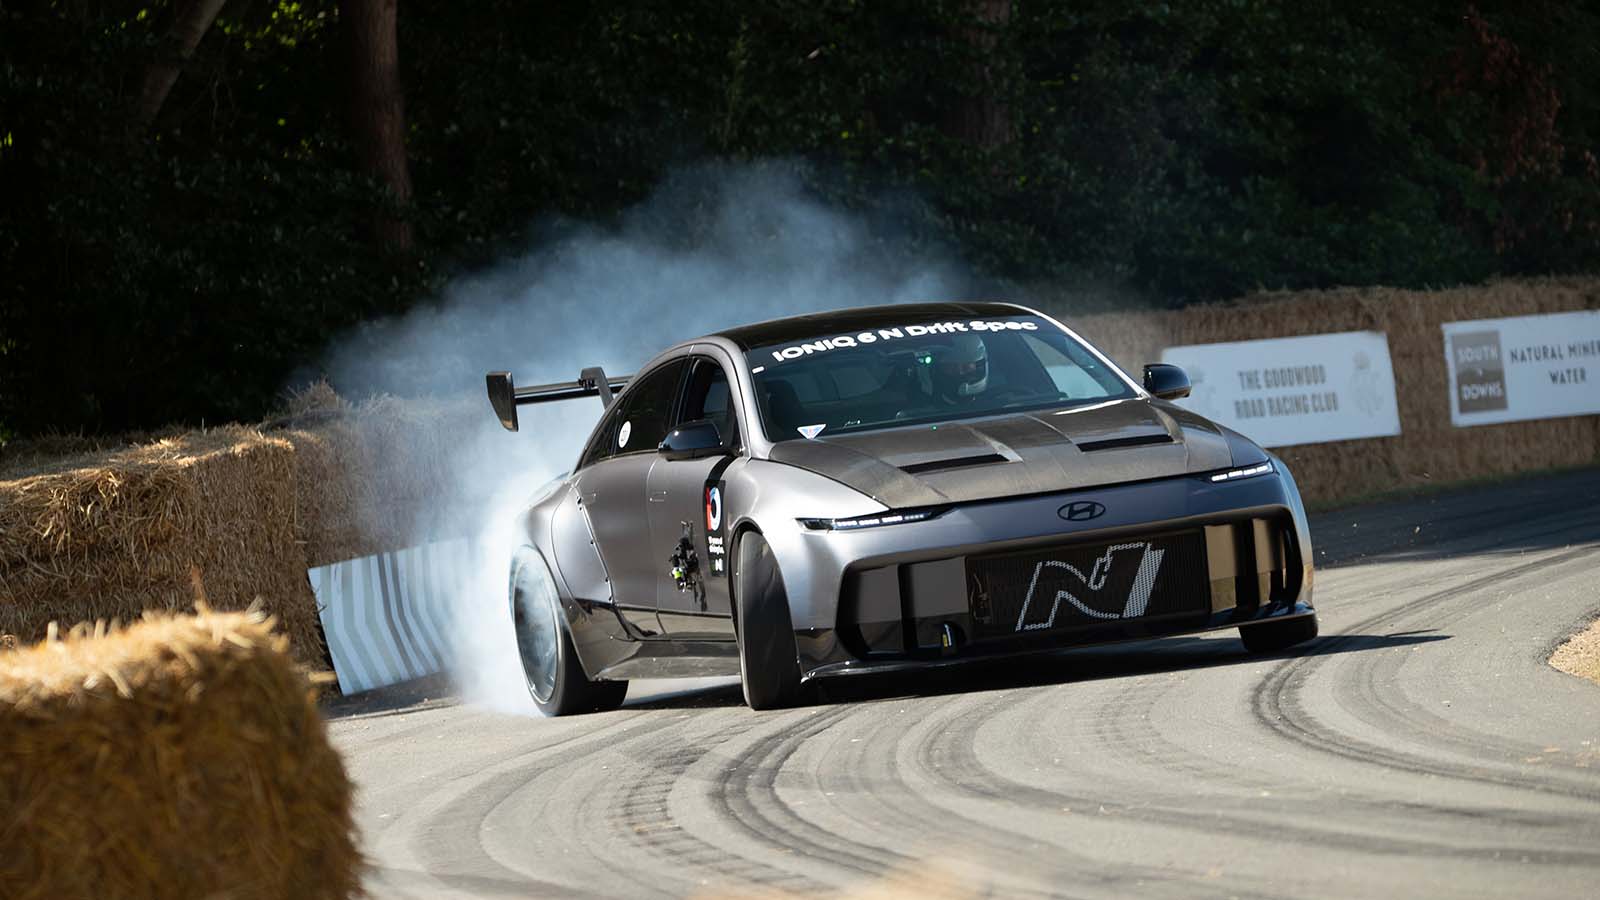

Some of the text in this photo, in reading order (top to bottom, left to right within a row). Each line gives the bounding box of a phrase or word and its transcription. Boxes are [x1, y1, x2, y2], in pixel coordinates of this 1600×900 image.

[772, 320, 1038, 362] IONIQ 6 N Drift Spec
[1456, 344, 1499, 363] SOUTH
[1509, 344, 1564, 363] NATURAL
[1237, 364, 1326, 390] THE GOODWOOD
[1548, 367, 1587, 385] WATER
[1461, 382, 1503, 400] DOWNS
[1234, 391, 1339, 419] ROAD RACING CLUB
